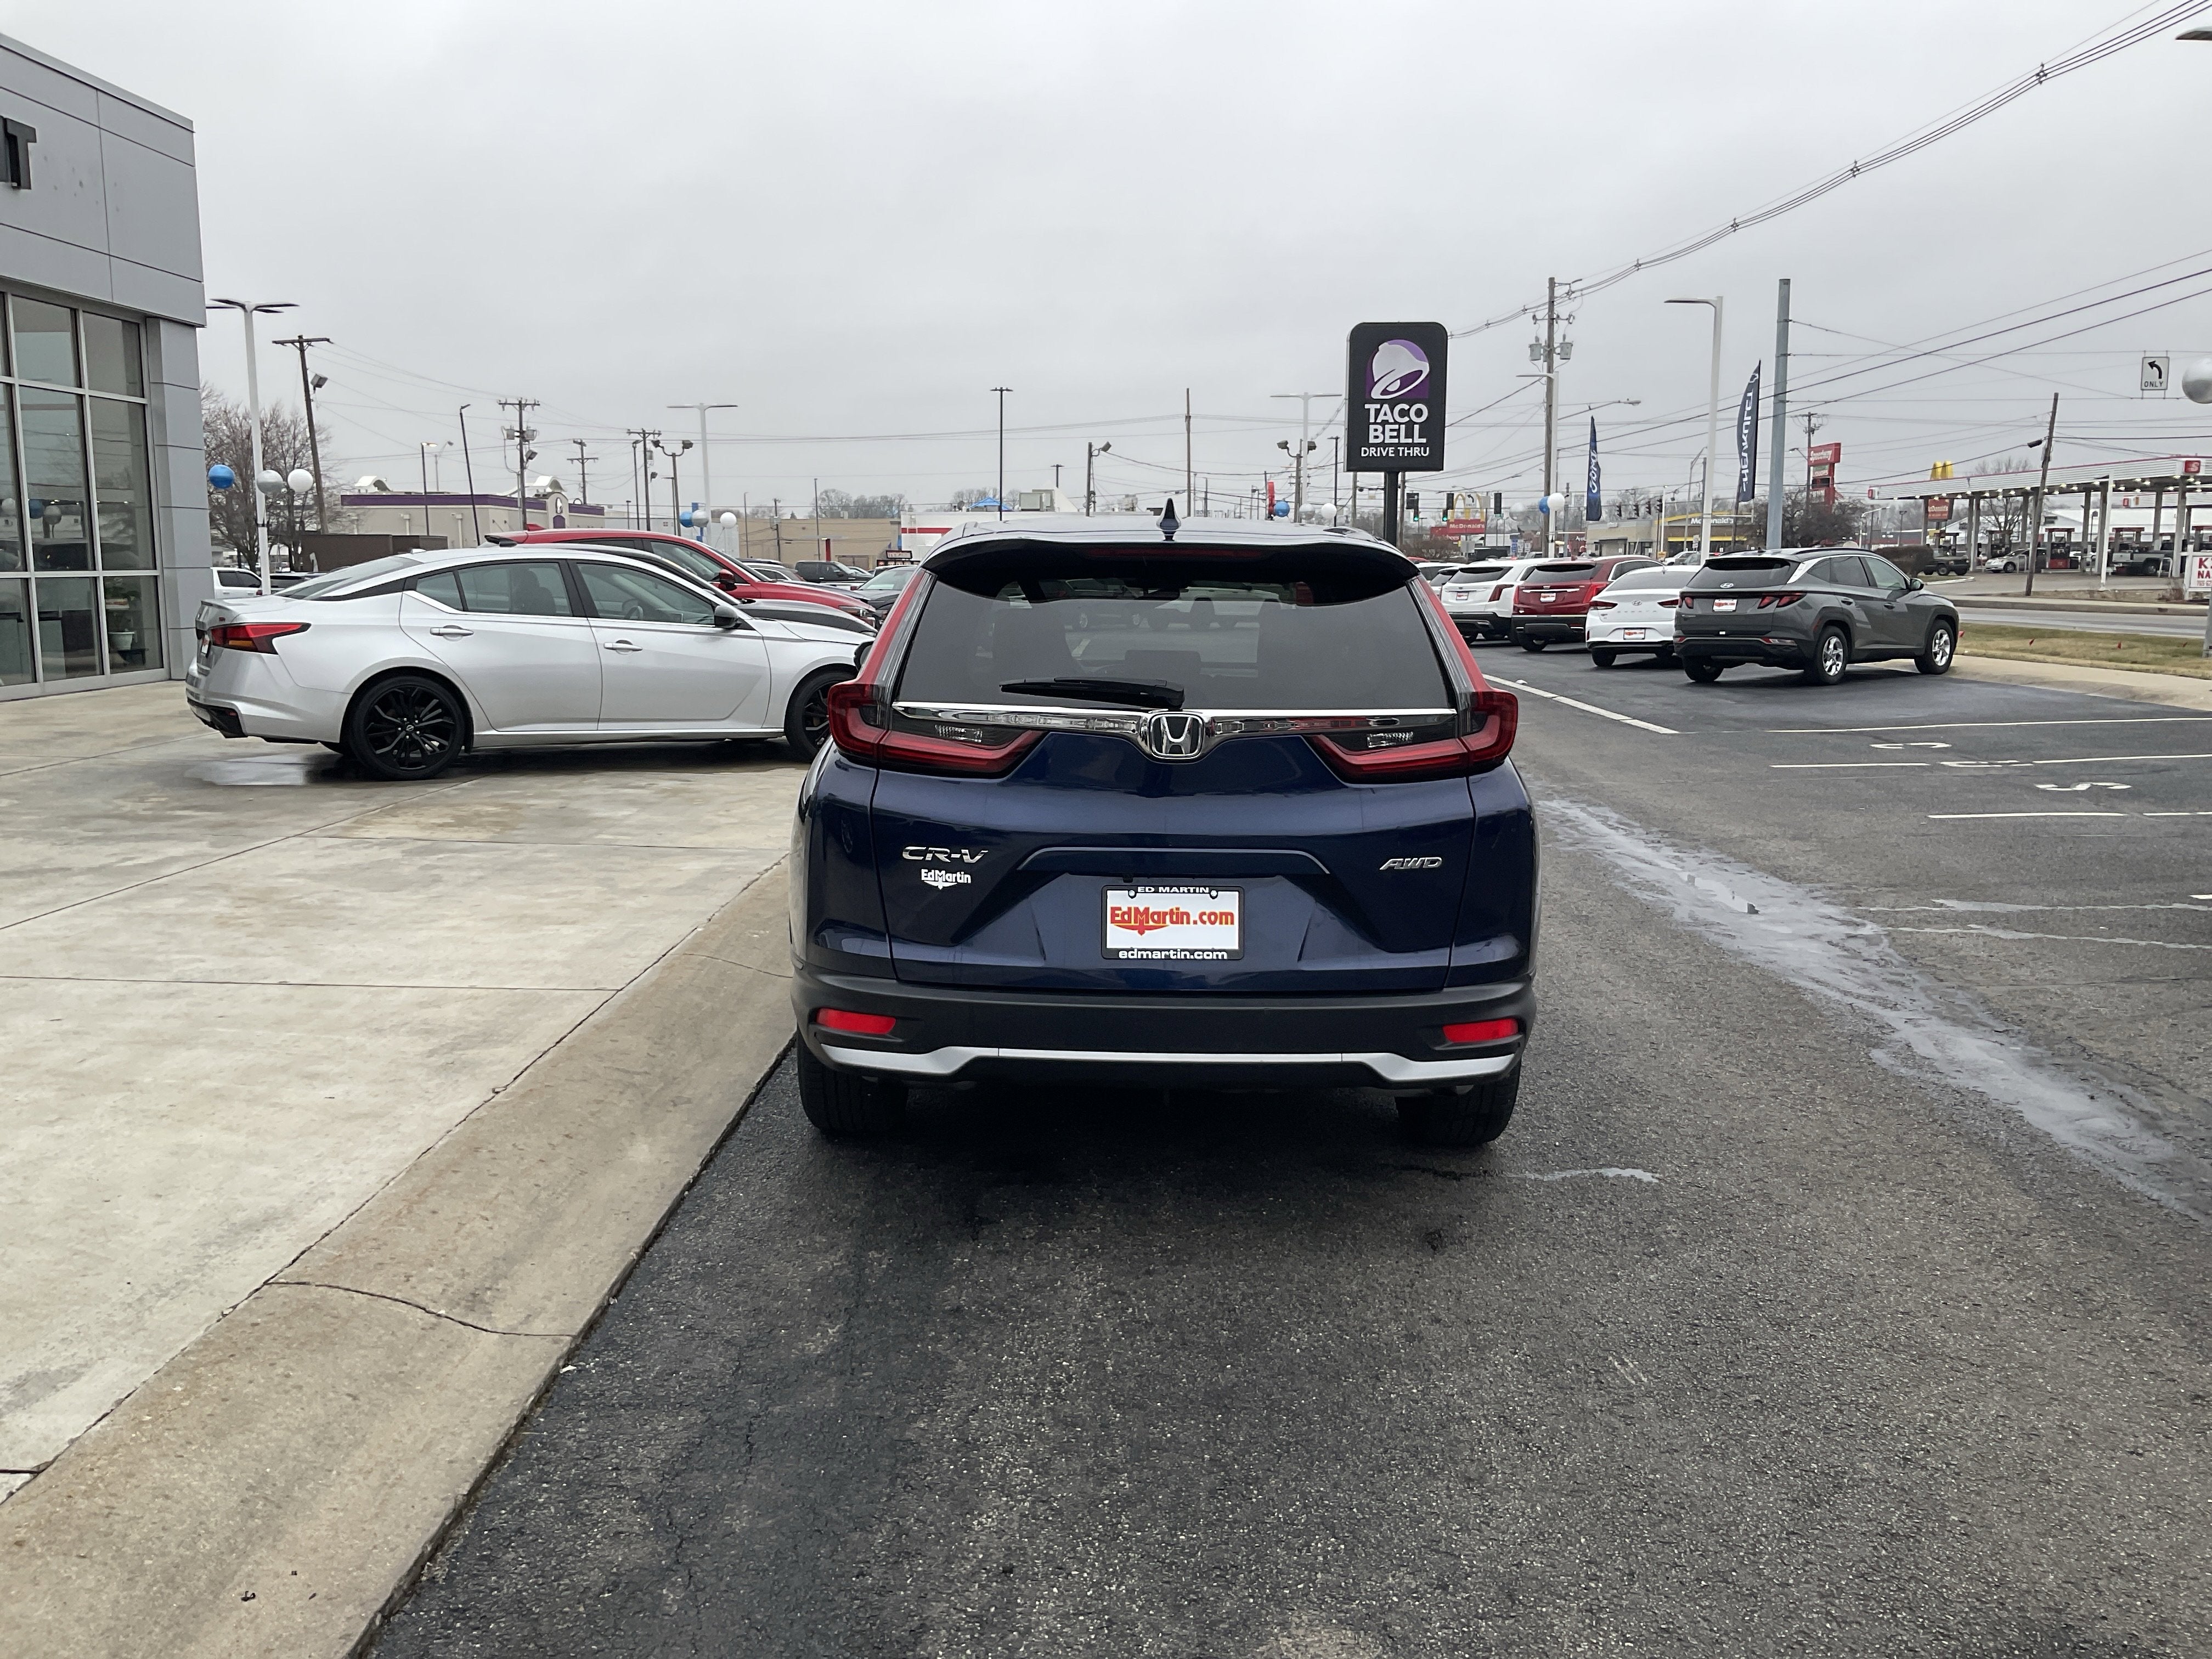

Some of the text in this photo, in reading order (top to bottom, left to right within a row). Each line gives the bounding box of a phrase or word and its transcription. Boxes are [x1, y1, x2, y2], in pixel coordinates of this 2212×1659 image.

[1364, 403, 1429, 423] TACO
[1369, 424, 1426, 443] BELL
[1361, 447, 1430, 456] DRIVE THRU
[1589, 450, 1598, 493] Ford
[902, 846, 989, 863] CR-V
[1379, 856, 1442, 870] AWD
[1110, 906, 1235, 926] EdMartin.com
[1119, 949, 1228, 960] edmartin.com
